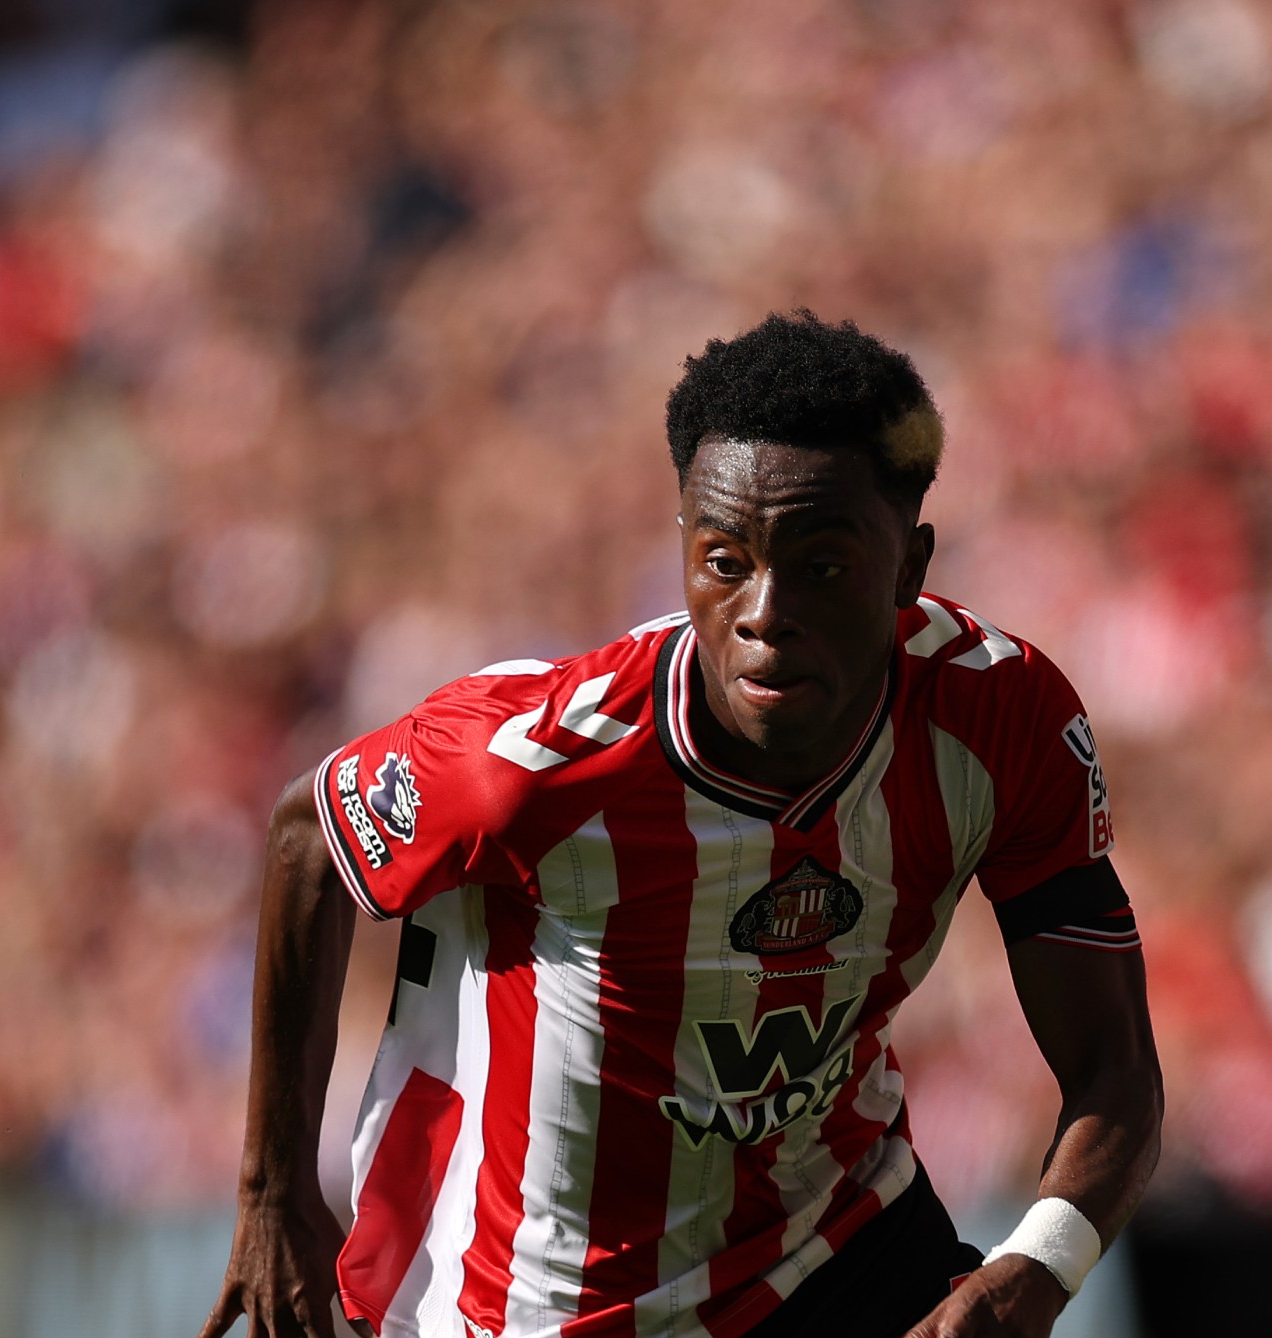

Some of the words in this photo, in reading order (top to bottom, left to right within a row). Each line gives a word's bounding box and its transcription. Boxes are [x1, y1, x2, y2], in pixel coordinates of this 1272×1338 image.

[340, 796, 382, 870] racism
[351, 793, 386, 855] room
[762, 936, 807, 949] SUNDERLAND
